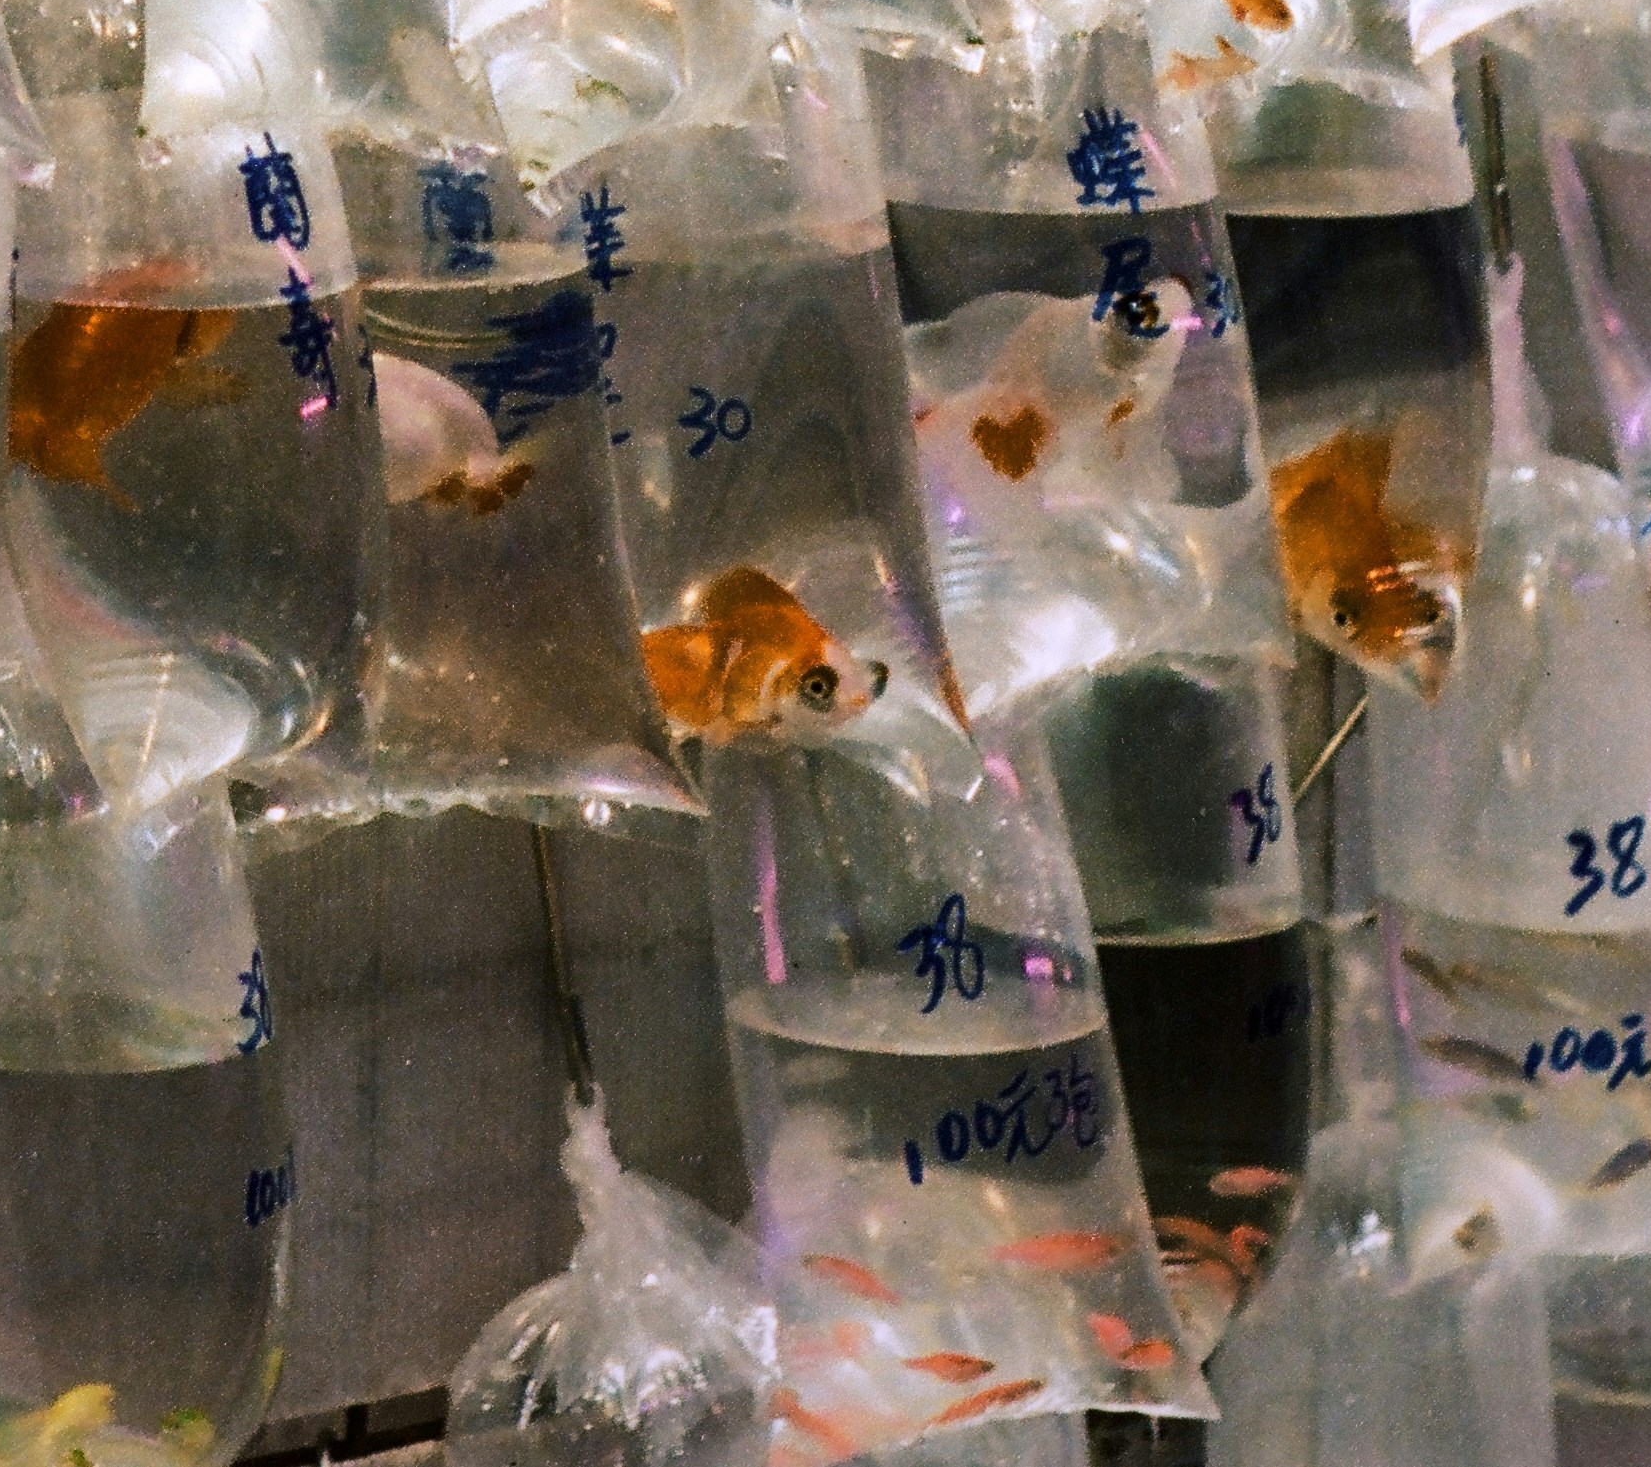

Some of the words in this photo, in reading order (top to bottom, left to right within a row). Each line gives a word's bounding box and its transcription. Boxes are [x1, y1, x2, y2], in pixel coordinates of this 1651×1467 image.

[680, 387, 752, 457] 30
[1564, 814, 1647, 915] 38
[900, 894, 987, 1014] 38
